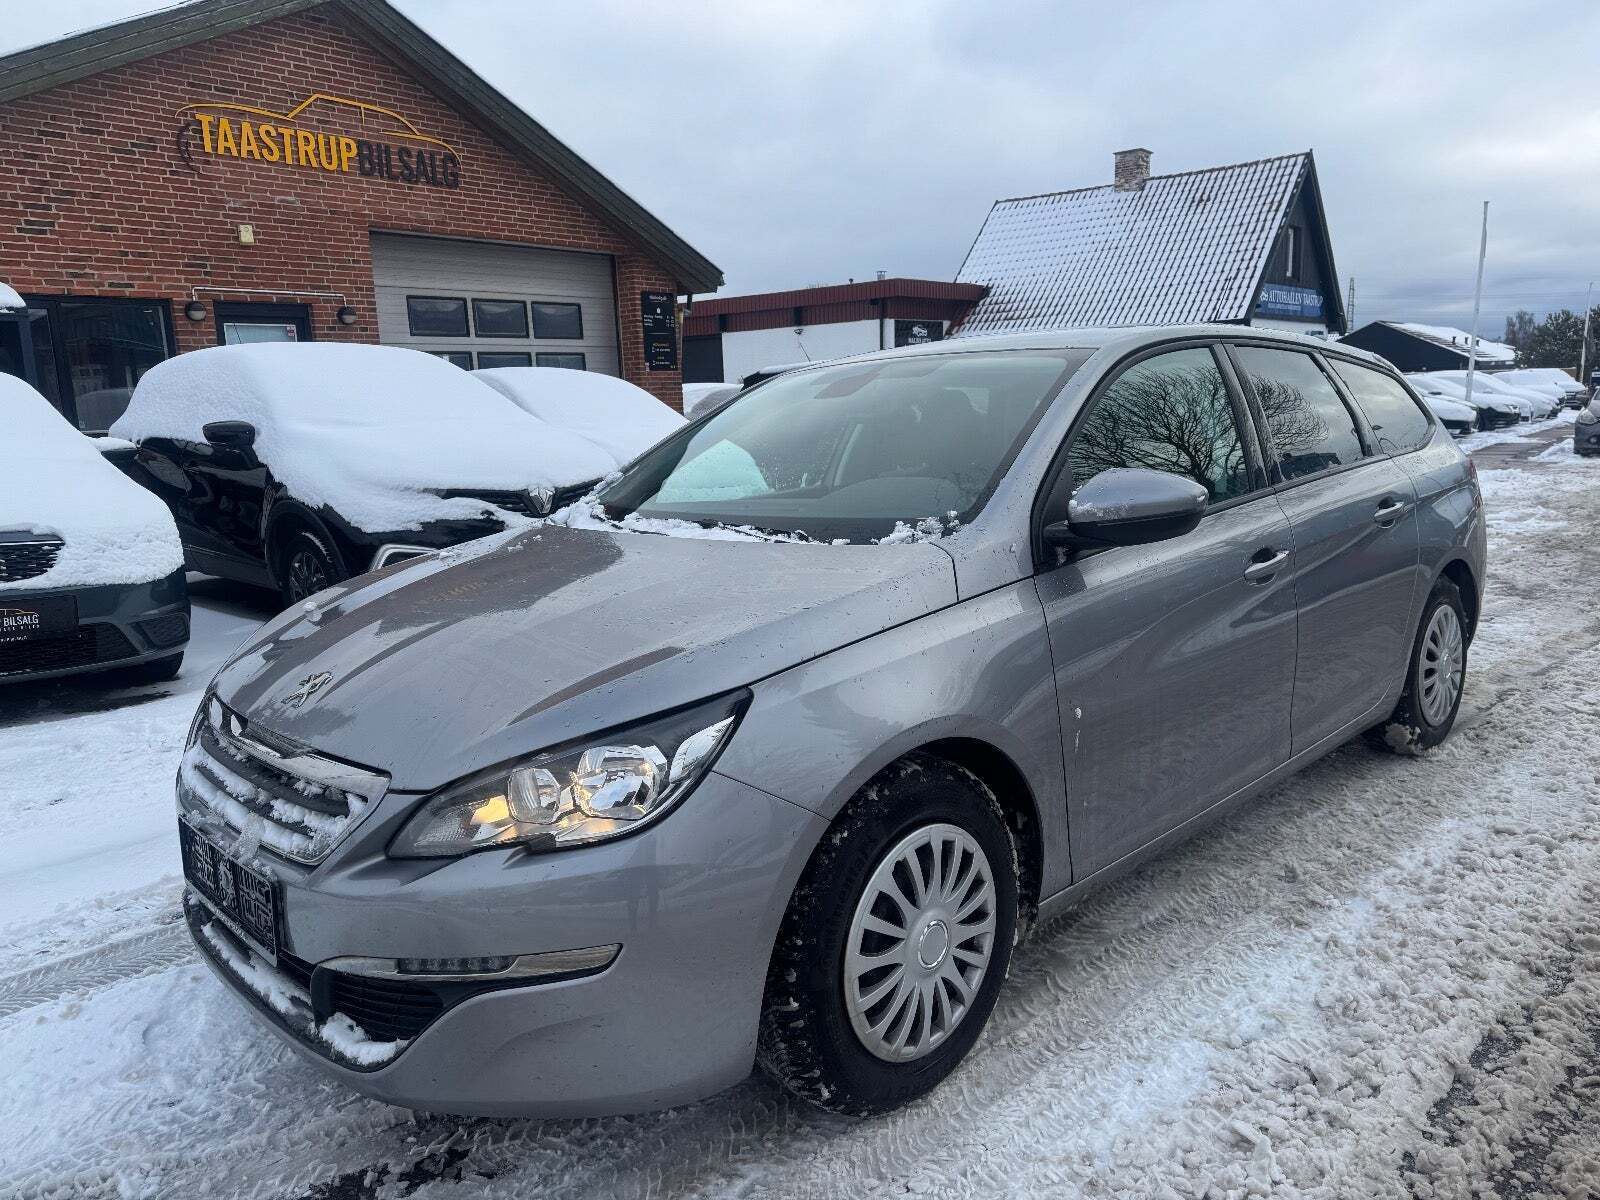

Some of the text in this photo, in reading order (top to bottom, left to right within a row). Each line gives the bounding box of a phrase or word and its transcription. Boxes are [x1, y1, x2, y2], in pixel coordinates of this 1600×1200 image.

[195, 113, 460, 189] TAASTRUP BILSALG
[3, 614, 39, 627] BILSALG
